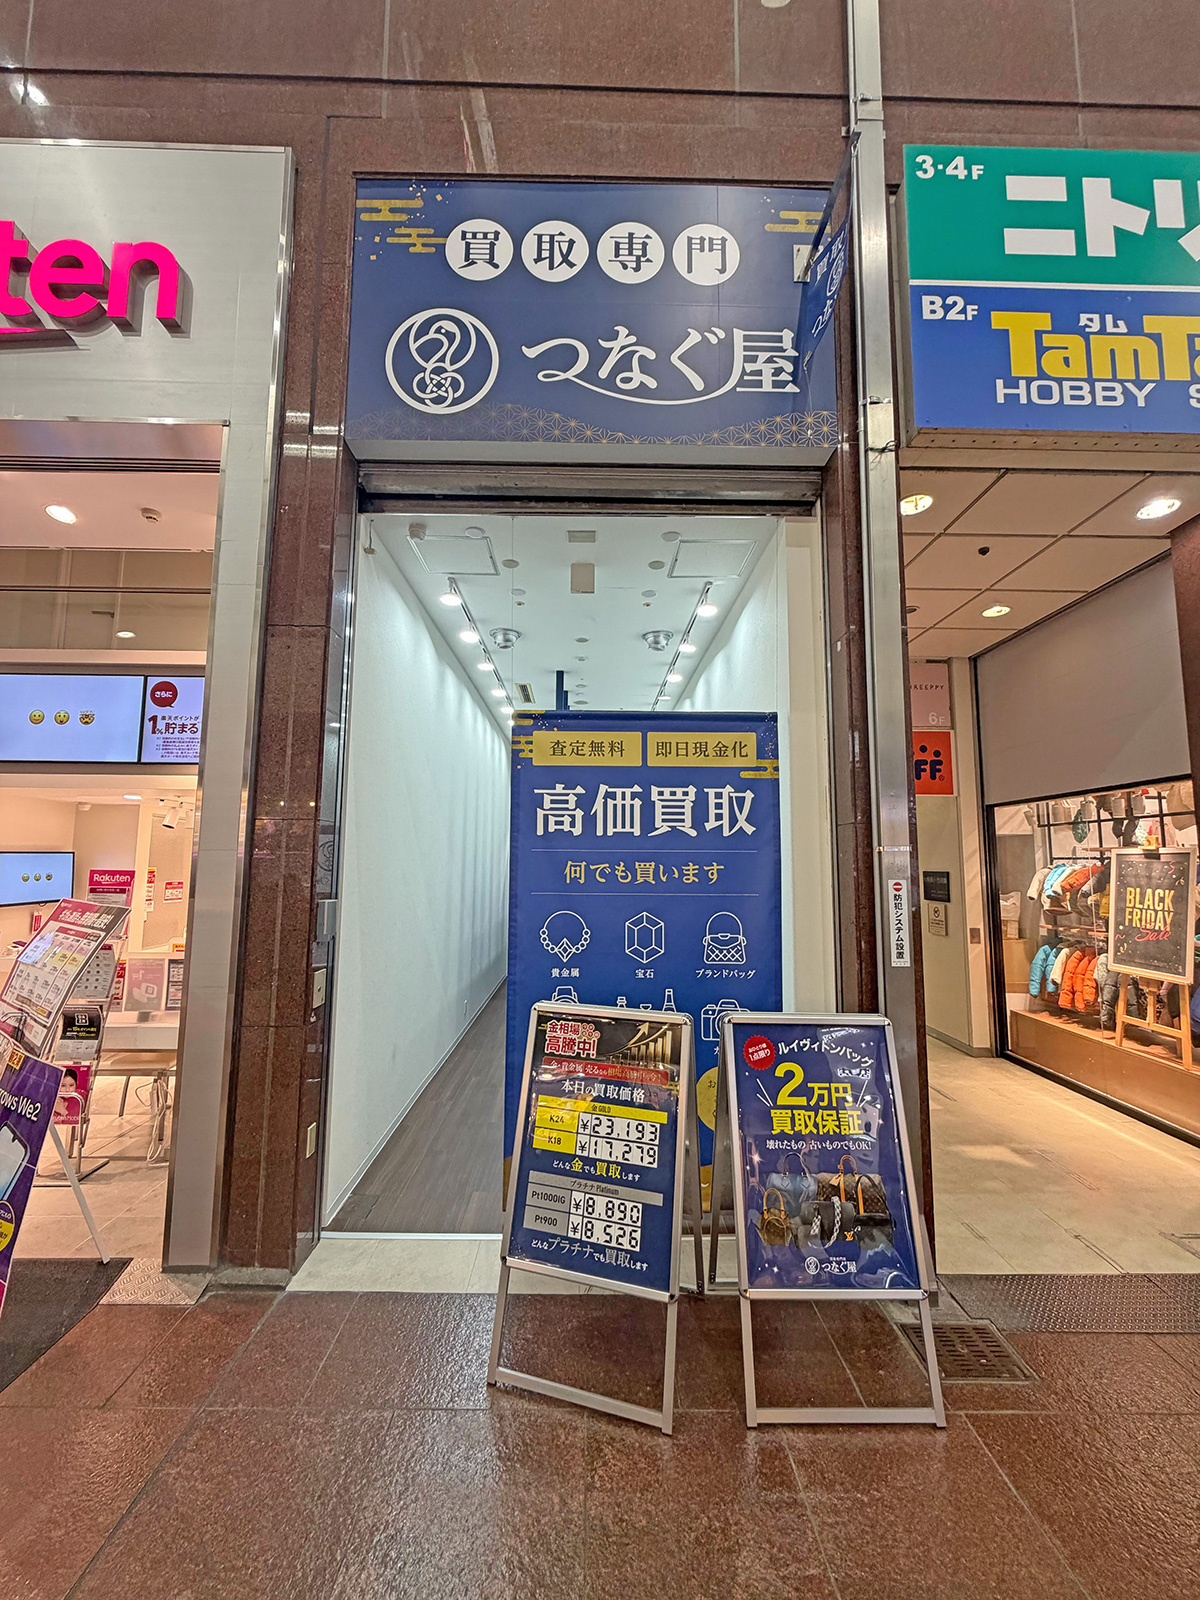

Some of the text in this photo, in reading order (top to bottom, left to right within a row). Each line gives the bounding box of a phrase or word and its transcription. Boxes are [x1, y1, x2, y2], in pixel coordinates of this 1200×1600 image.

[458, 229, 728, 275] 買取専門
[921, 295, 978, 321] B2F
[1079, 313, 1128, 333] タム
[991, 311, 1200, 381] TamT
[521, 326, 800, 405] つなぐ屋
[995, 379, 1157, 408] HOBBY
[164, 722, 199, 734] 貯まる
[549, 740, 625, 758] 査定無料
[655, 741, 749, 758] 即日現金化
[533, 784, 757, 837] 高価買取
[93, 873, 131, 883] Rakuten
[564, 861, 725, 885] 何でも買います
[1126, 887, 1175, 911] BLACK
[893, 893, 905, 960] 防犯システム設置
[1125, 907, 1174, 931] FRIDAY
[551, 968, 580, 978] 貴金属
[635, 969, 654, 979] 宝石
[695, 969, 756, 980] ブランドバッグ
[547, 1020, 580, 1036] 金相場
[778, 1038, 875, 1068] ルイヴィトンバッグ
[561, 1079, 645, 1103] 本日の買取価格
[775, 1062, 853, 1107] 2万円
[549, 1114, 564, 1124] K24
[770, 1109, 863, 1135] 買取保証
[547, 1135, 562, 1145] K18
[766, 1140, 806, 1150] 壊れたもの
[552, 1157, 640, 1181] どんな金でも買取します
[570, 1180, 620, 1196] プラチナ Platinum
[534, 1214, 558, 1227] Pt900
[531, 1236, 648, 1272] どんなプラチナでも買取します
[822, 1261, 857, 1275] つなぐ屋
